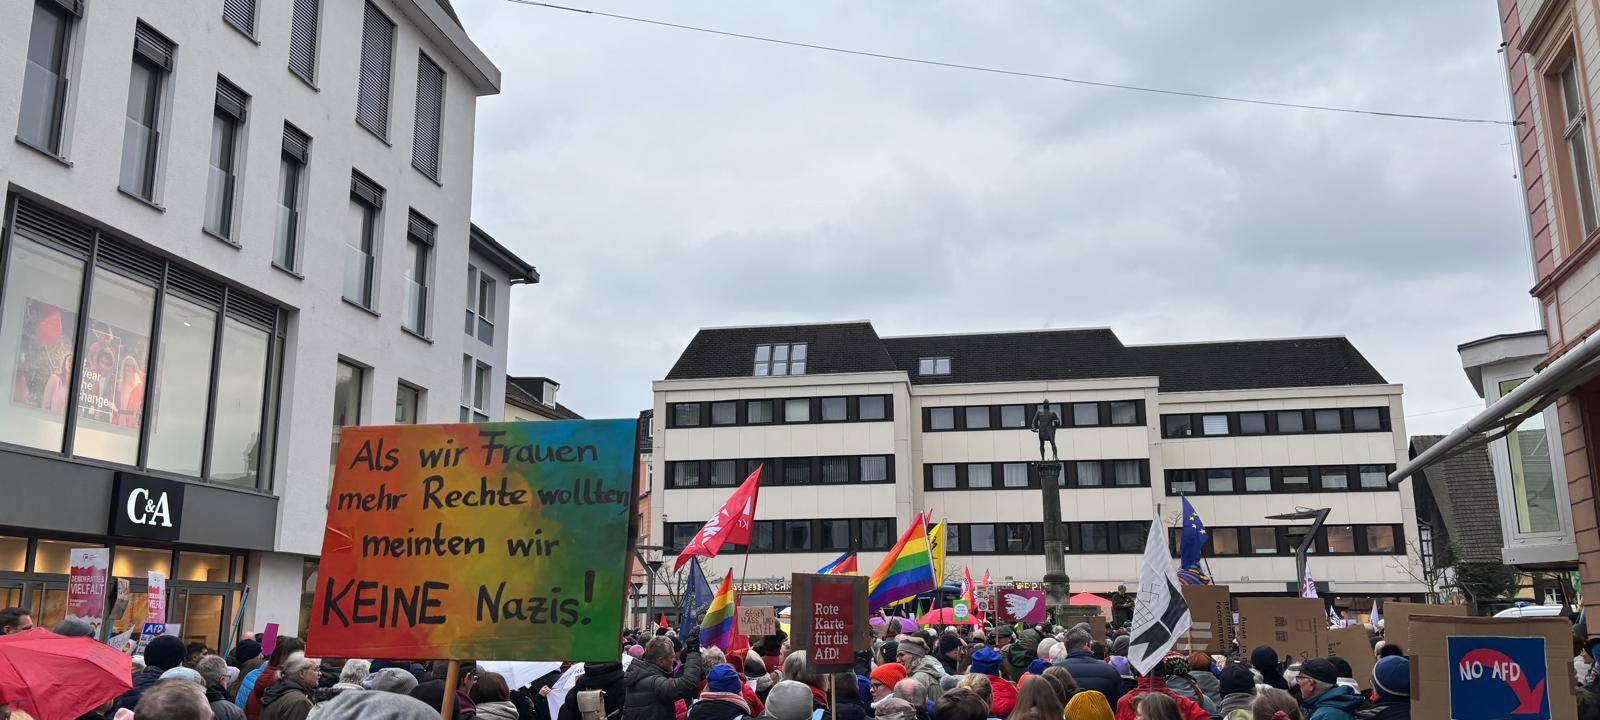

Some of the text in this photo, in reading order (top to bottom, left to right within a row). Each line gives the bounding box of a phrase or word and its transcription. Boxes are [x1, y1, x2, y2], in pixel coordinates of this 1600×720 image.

[350, 430, 599, 471] Als wir Frauen
[338, 484, 407, 512] mehr
[422, 475, 527, 511] Rechte
[127, 487, 172, 527] C&A
[362, 522, 559, 558] meinten wir
[71, 583, 105, 595] VIELFALT
[322, 570, 596, 628] KEINE Nazis!
[745, 608, 765, 618] GEGEN
[815, 603, 839, 615] Rote
[145, 624, 163, 633] AfD
[815, 617, 844, 630] Karte
[815, 631, 849, 645] für die
[814, 647, 839, 660] AfD!
[1459, 660, 1520, 681] NO AFD
